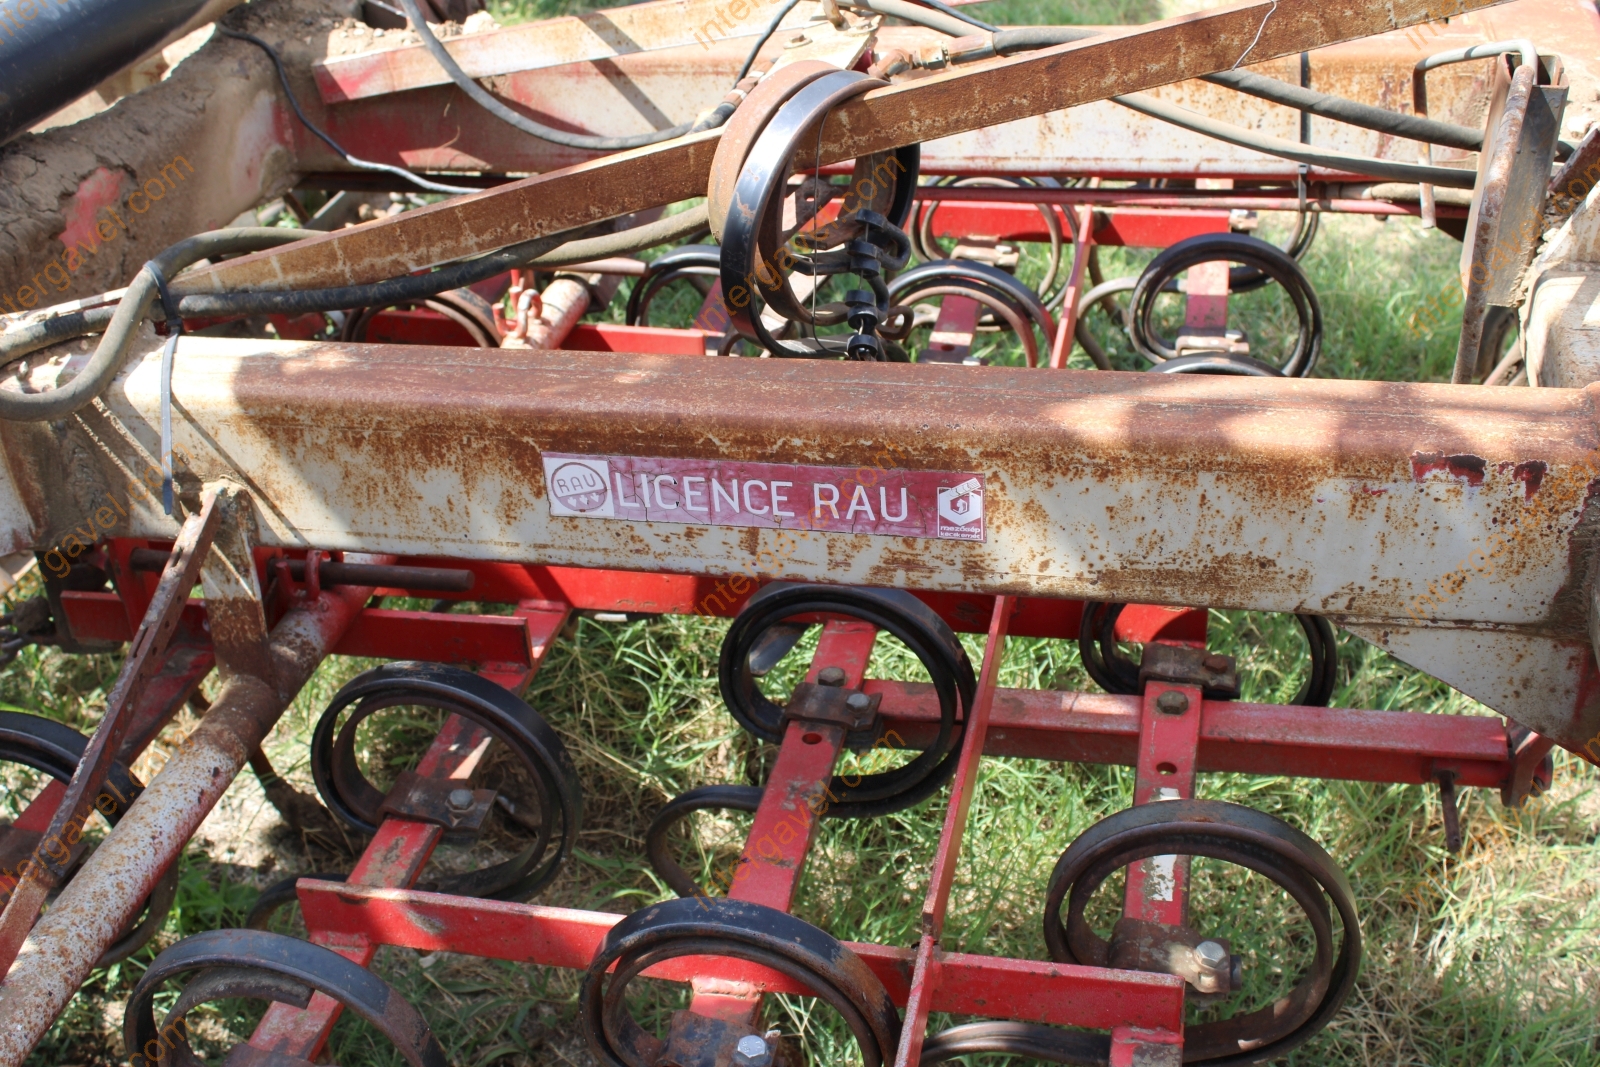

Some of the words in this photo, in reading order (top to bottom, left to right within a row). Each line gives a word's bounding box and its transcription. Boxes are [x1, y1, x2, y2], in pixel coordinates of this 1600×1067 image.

[556, 473, 597, 494] RAU
[615, 472, 795, 517] LICENCE
[813, 482, 908, 522] RAU
